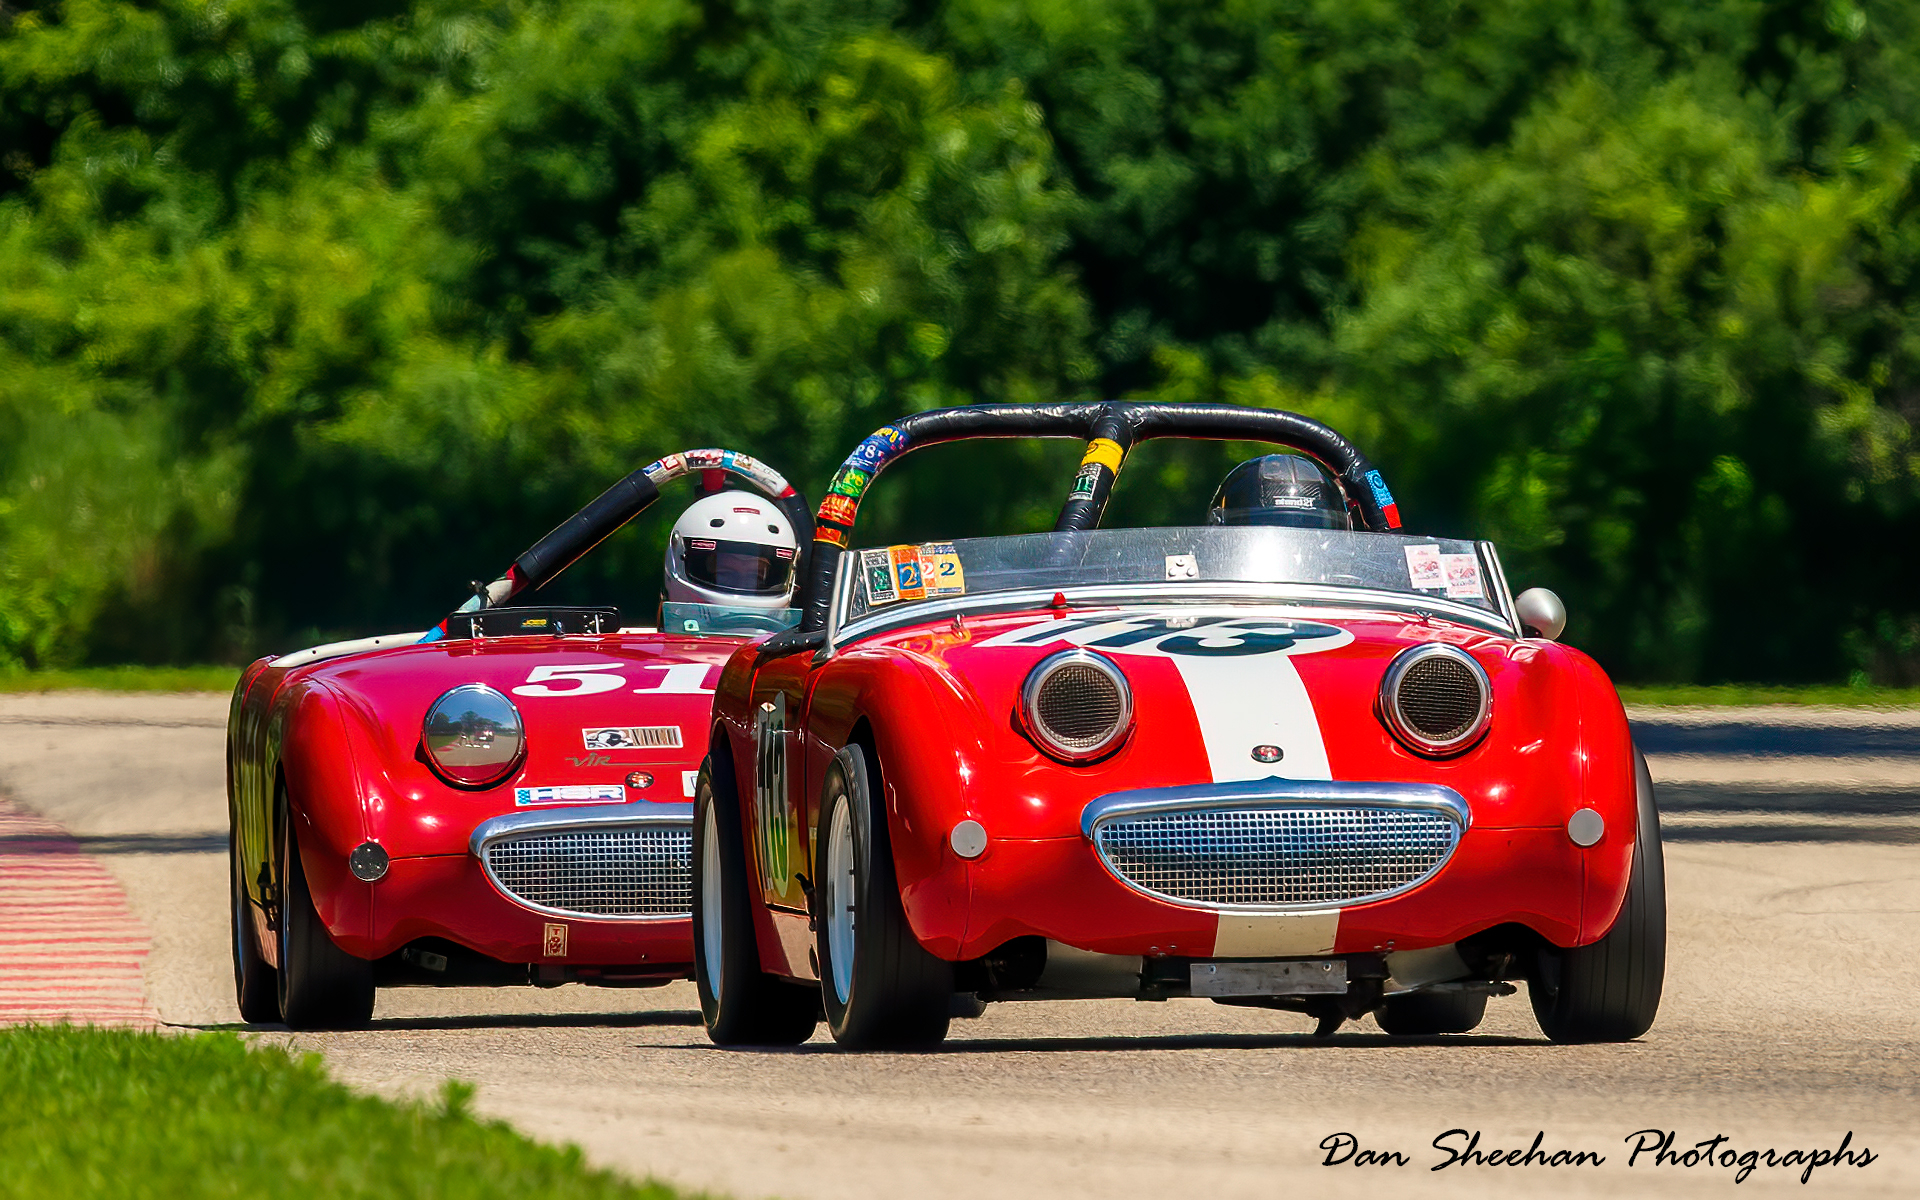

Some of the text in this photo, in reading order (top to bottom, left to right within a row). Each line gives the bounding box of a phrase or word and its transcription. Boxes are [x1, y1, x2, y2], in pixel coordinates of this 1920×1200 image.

[900, 565, 918, 586] 2
[940, 562, 956, 576] 2
[512, 663, 715, 697] 51
[529, 786, 622, 801] HSR
